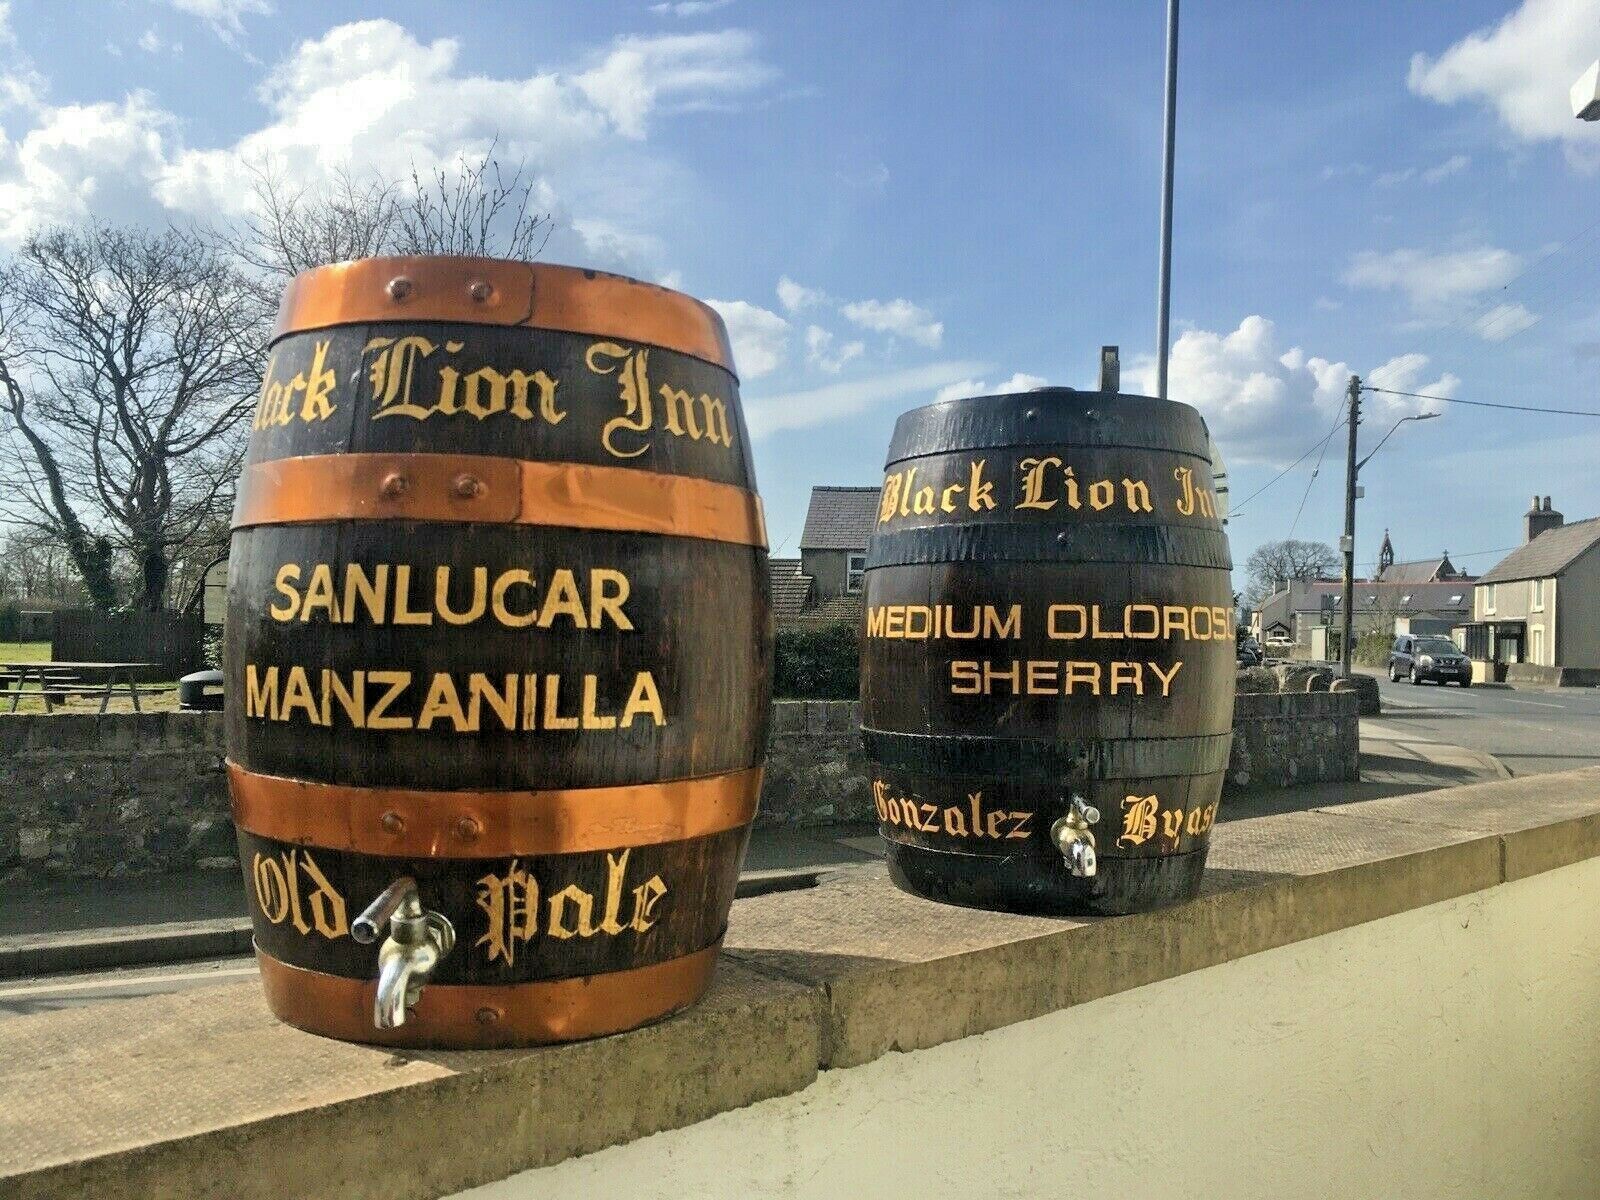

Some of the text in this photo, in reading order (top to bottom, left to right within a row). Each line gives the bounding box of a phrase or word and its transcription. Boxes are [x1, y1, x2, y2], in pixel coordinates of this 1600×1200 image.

[252, 336, 732, 458] lack Lion Inn
[878, 457, 1219, 526] Black Lion In
[269, 563, 634, 631] SANLUCAR
[866, 604, 1023, 640] MEDIUM
[245, 663, 667, 733] MANZANILLA
[951, 660, 1183, 697] SHERRY
[873, 779, 1216, 852] Gonzalez Byas
[253, 847, 669, 969] Old Pale
